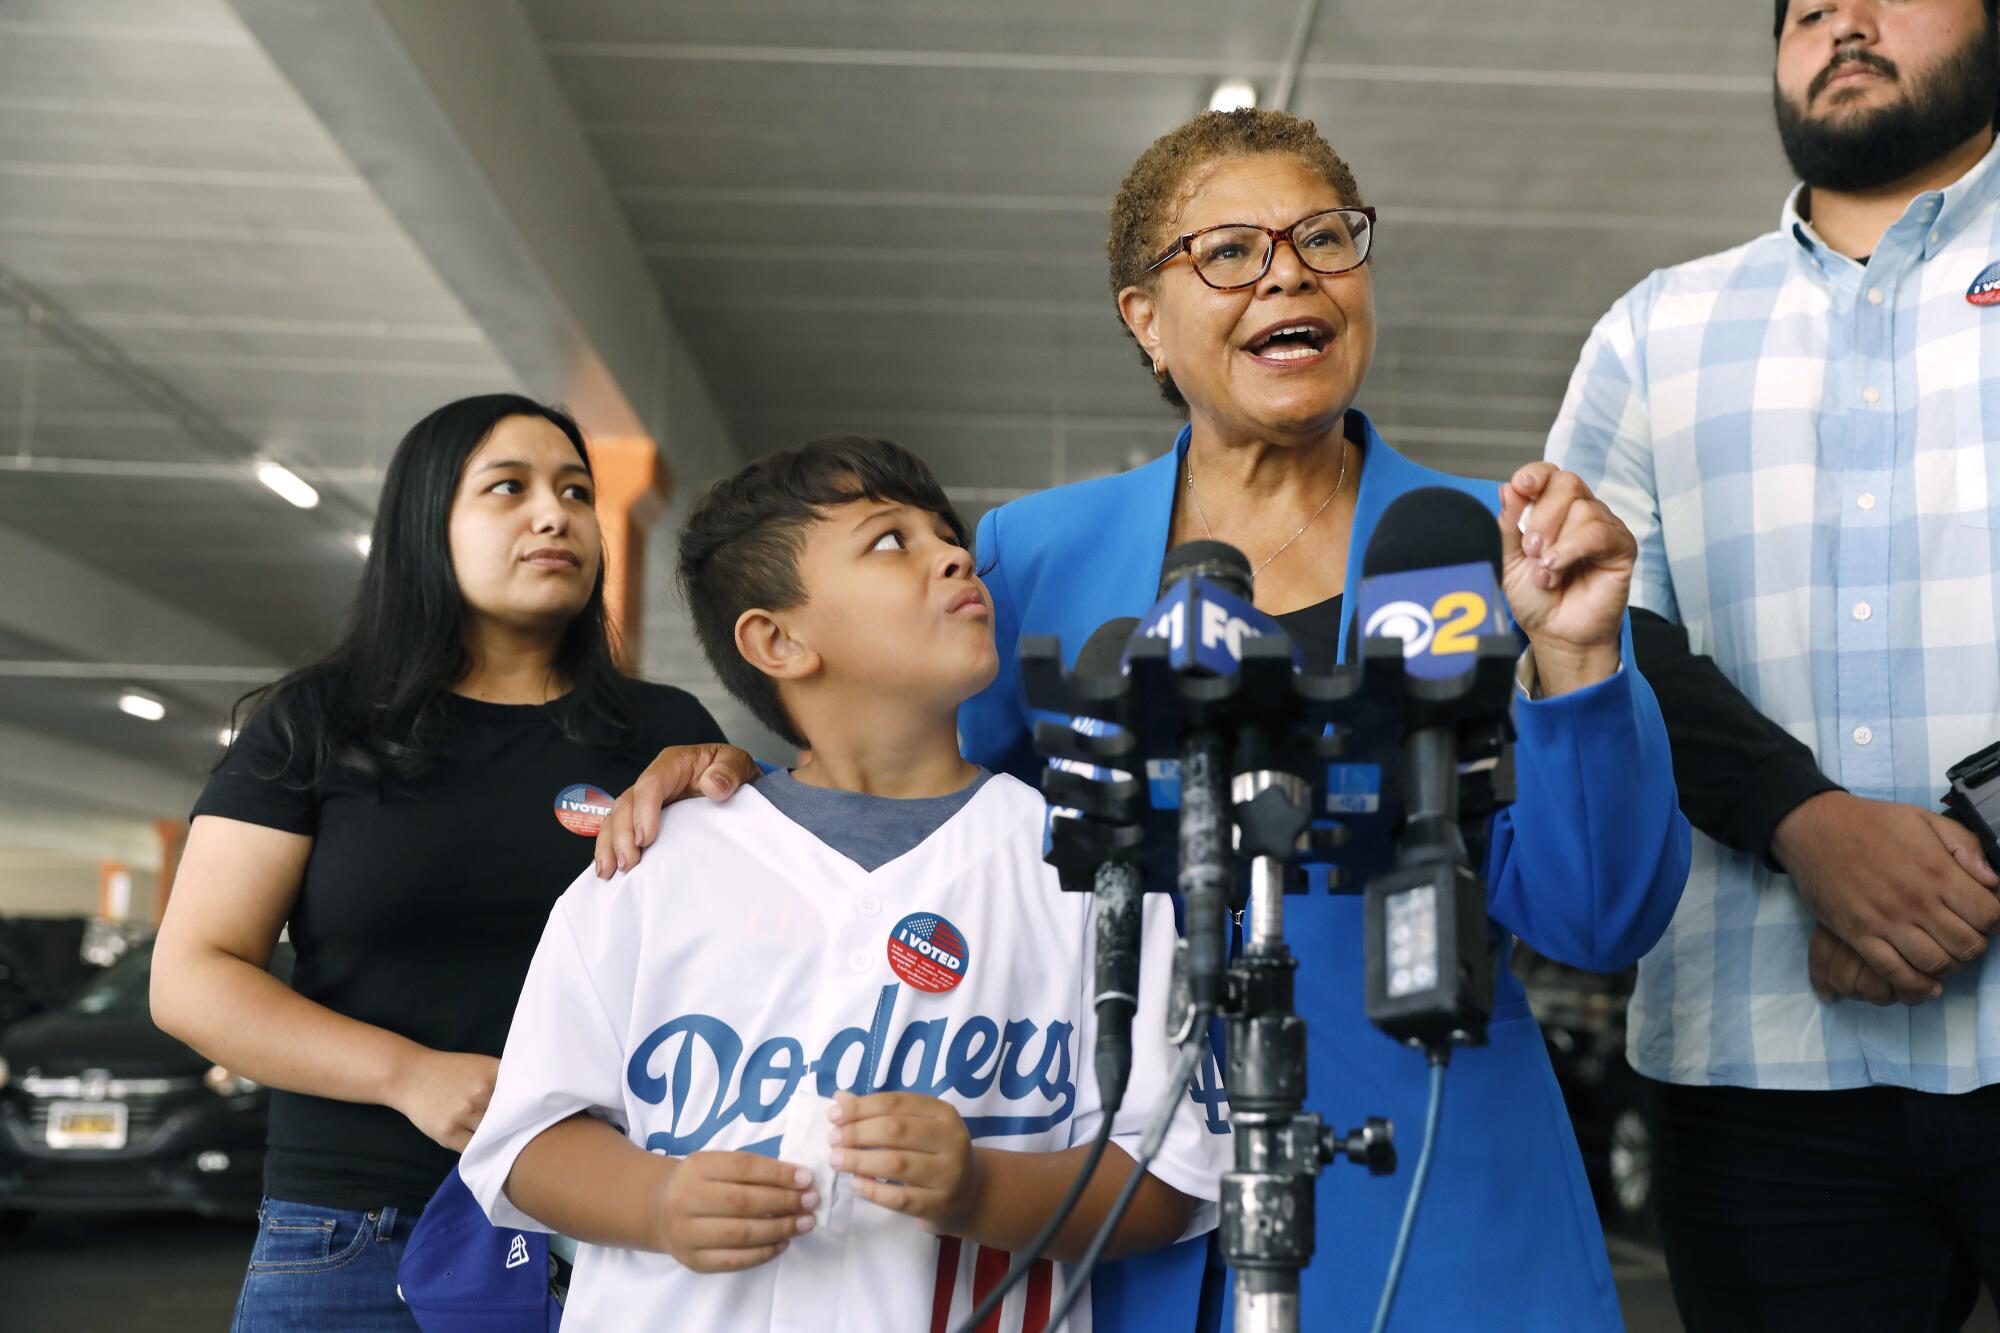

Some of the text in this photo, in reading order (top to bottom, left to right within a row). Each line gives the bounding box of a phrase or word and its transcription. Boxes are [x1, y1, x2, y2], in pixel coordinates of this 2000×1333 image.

[1974, 285, 1980, 294] I
[1430, 591, 1488, 656] 2
[562, 800, 567, 809] I
[899, 929, 908, 941] I
[909, 933, 960, 970] VOTED
